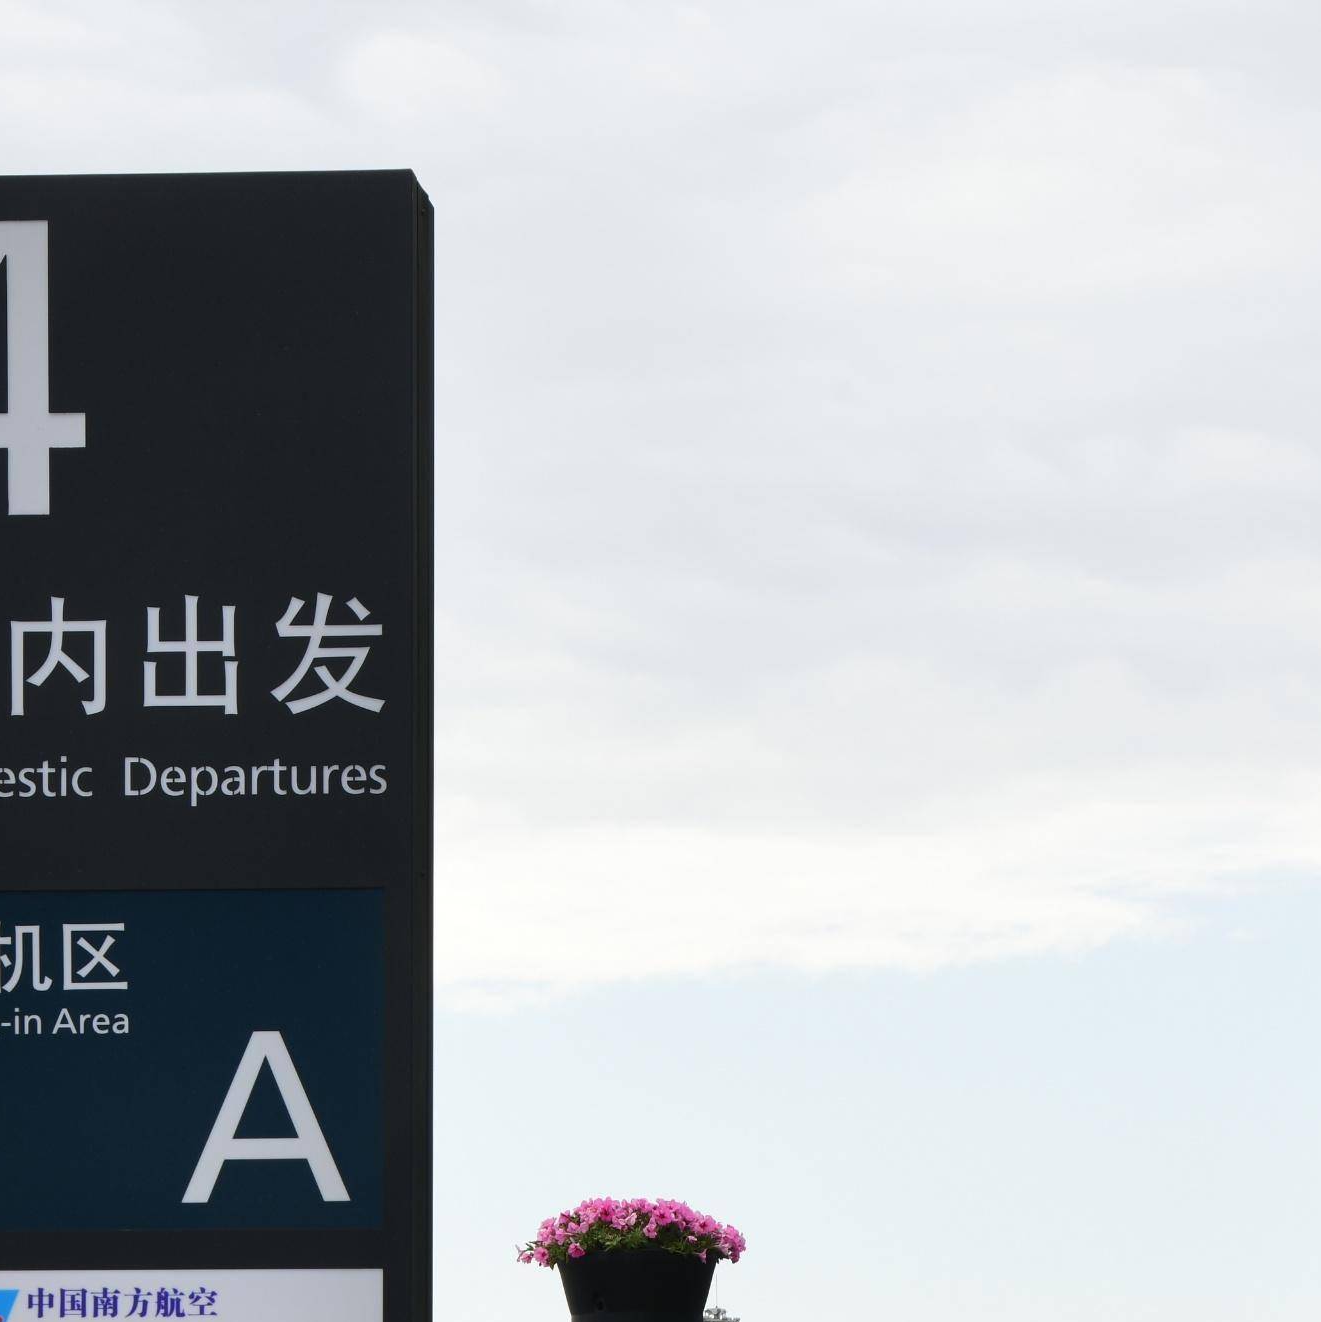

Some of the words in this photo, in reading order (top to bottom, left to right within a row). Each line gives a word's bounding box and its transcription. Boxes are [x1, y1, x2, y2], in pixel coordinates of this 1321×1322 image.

[123, 756, 388, 806] Departures
[52, 1008, 130, 1035] Area
[181, 1030, 351, 1203] A
[26, 1287, 218, 1320] 中国南方航空
